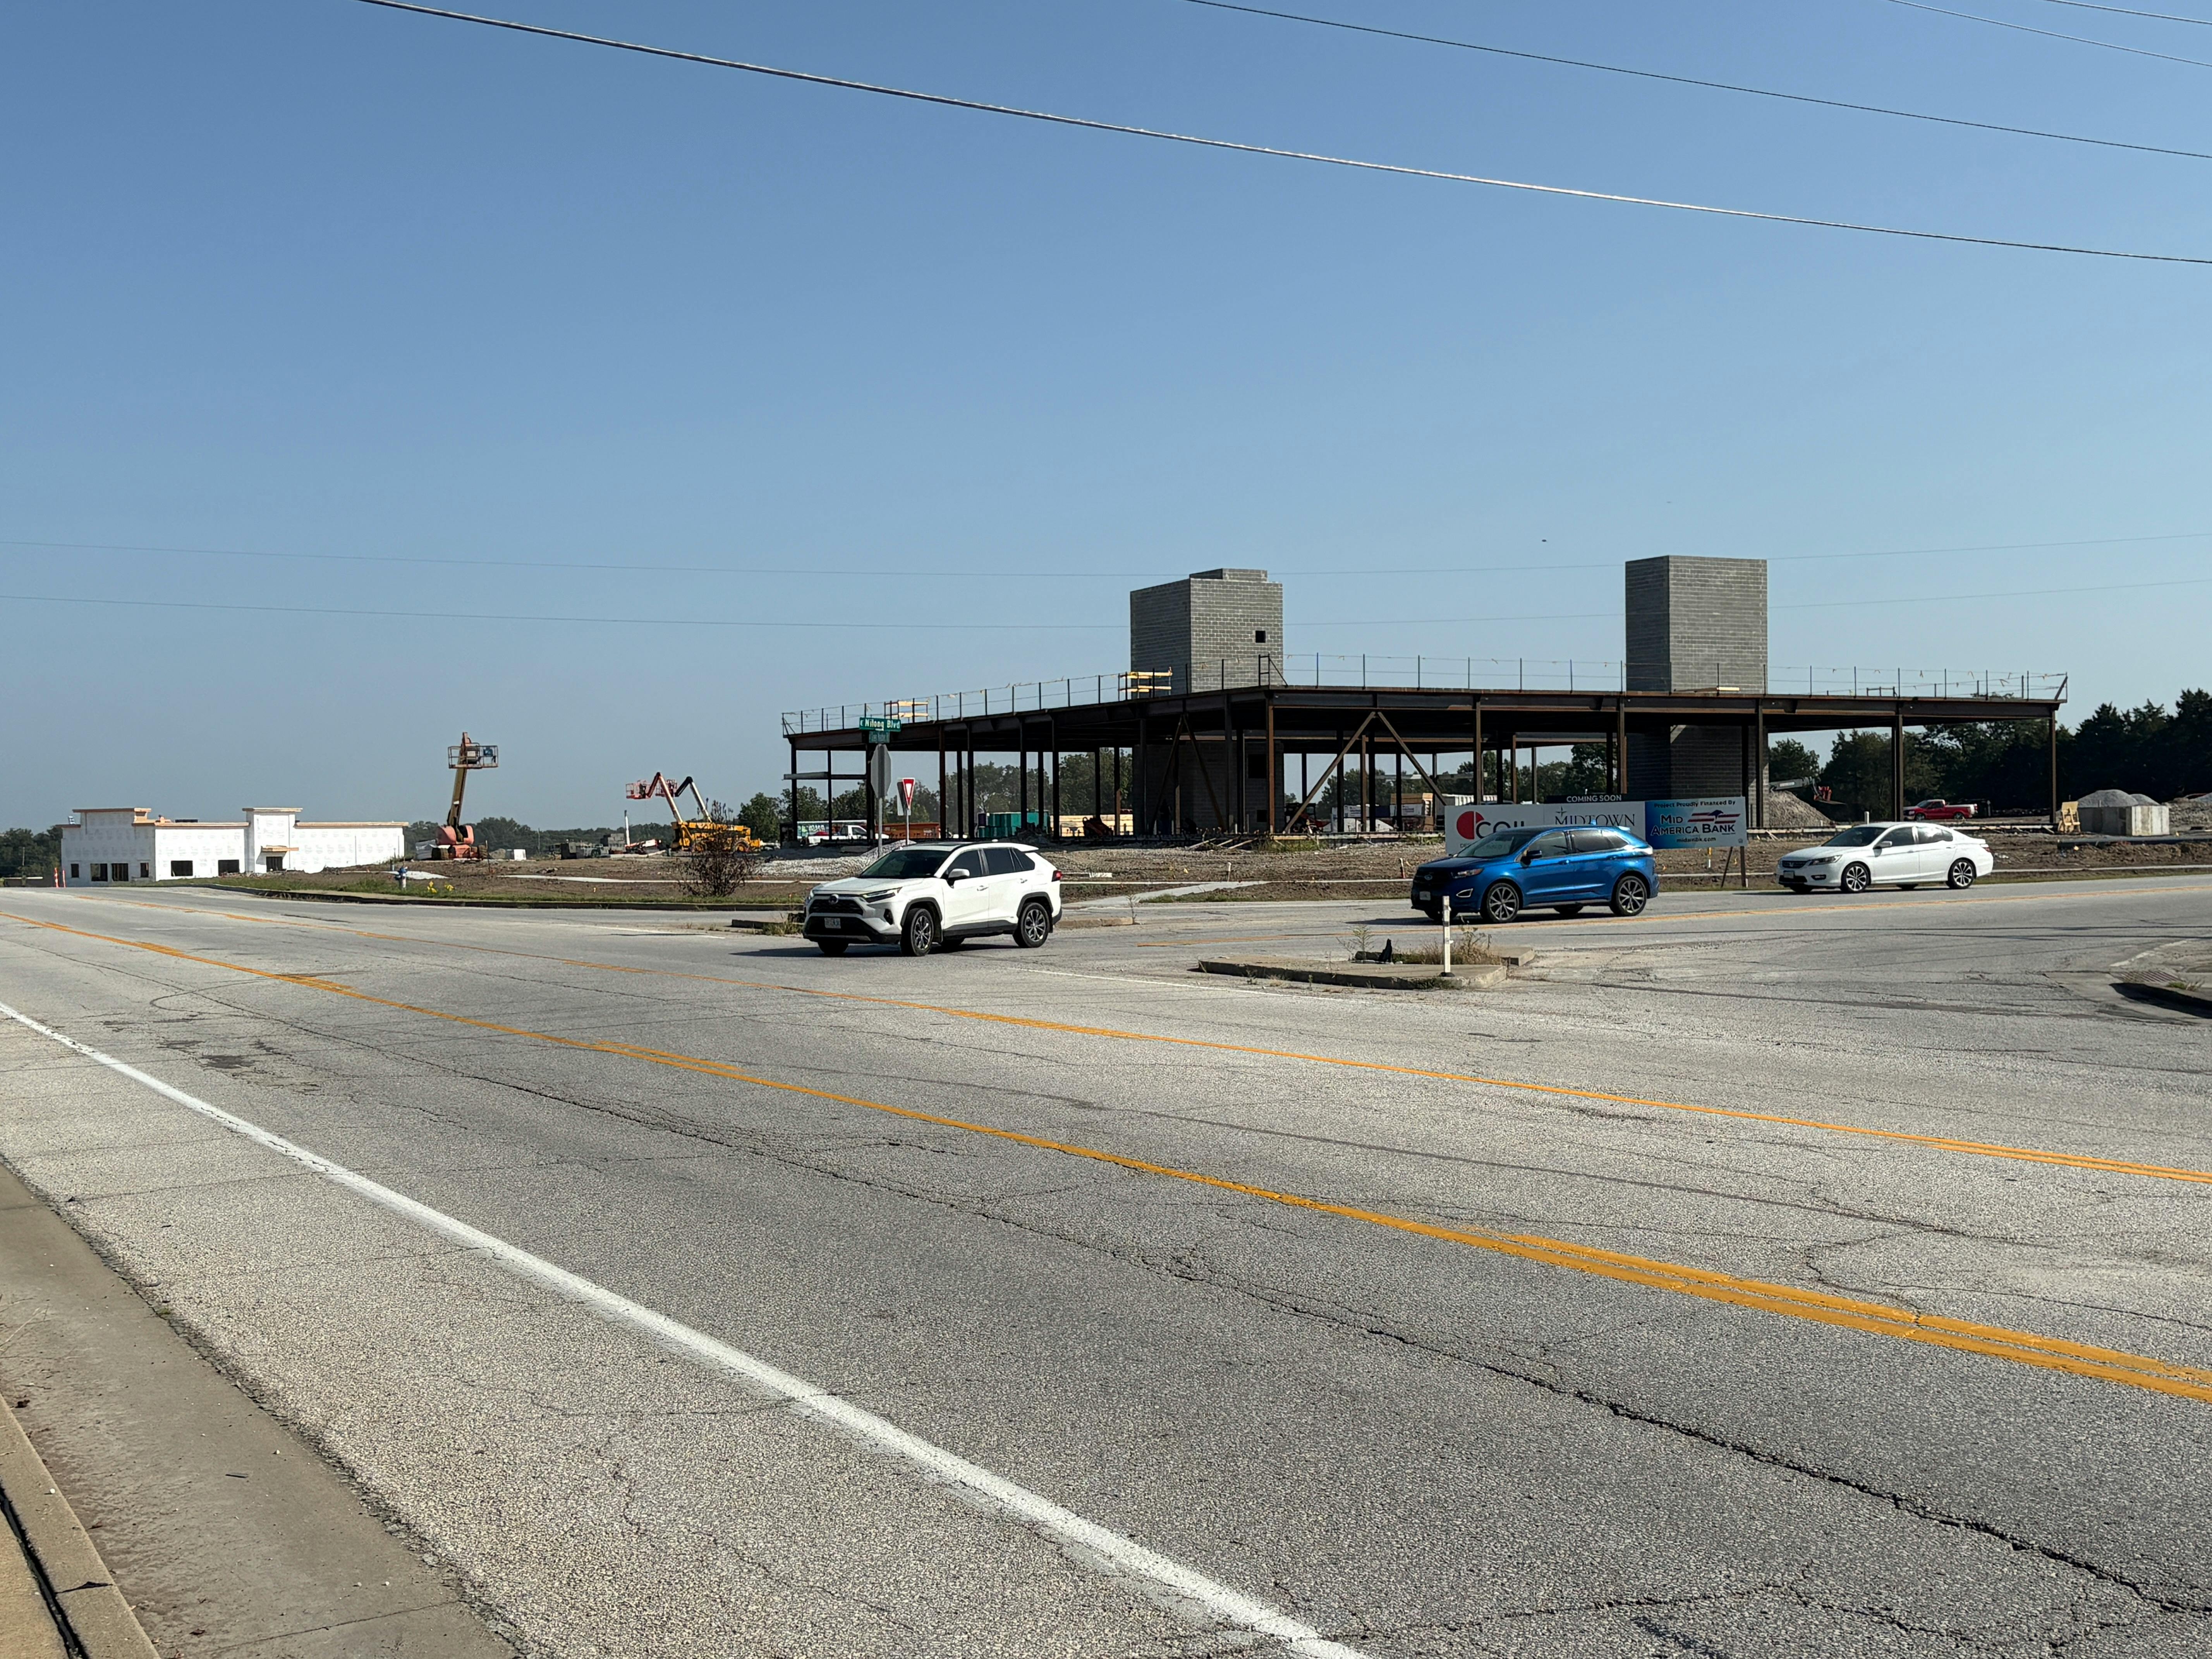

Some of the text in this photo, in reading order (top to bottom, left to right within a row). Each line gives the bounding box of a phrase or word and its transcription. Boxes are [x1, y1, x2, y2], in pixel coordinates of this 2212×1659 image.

[887, 720, 900, 728] Blvd
[1555, 814, 1635, 826] MIDTOWN
[1650, 824, 1735, 836] AMERICA BANK
